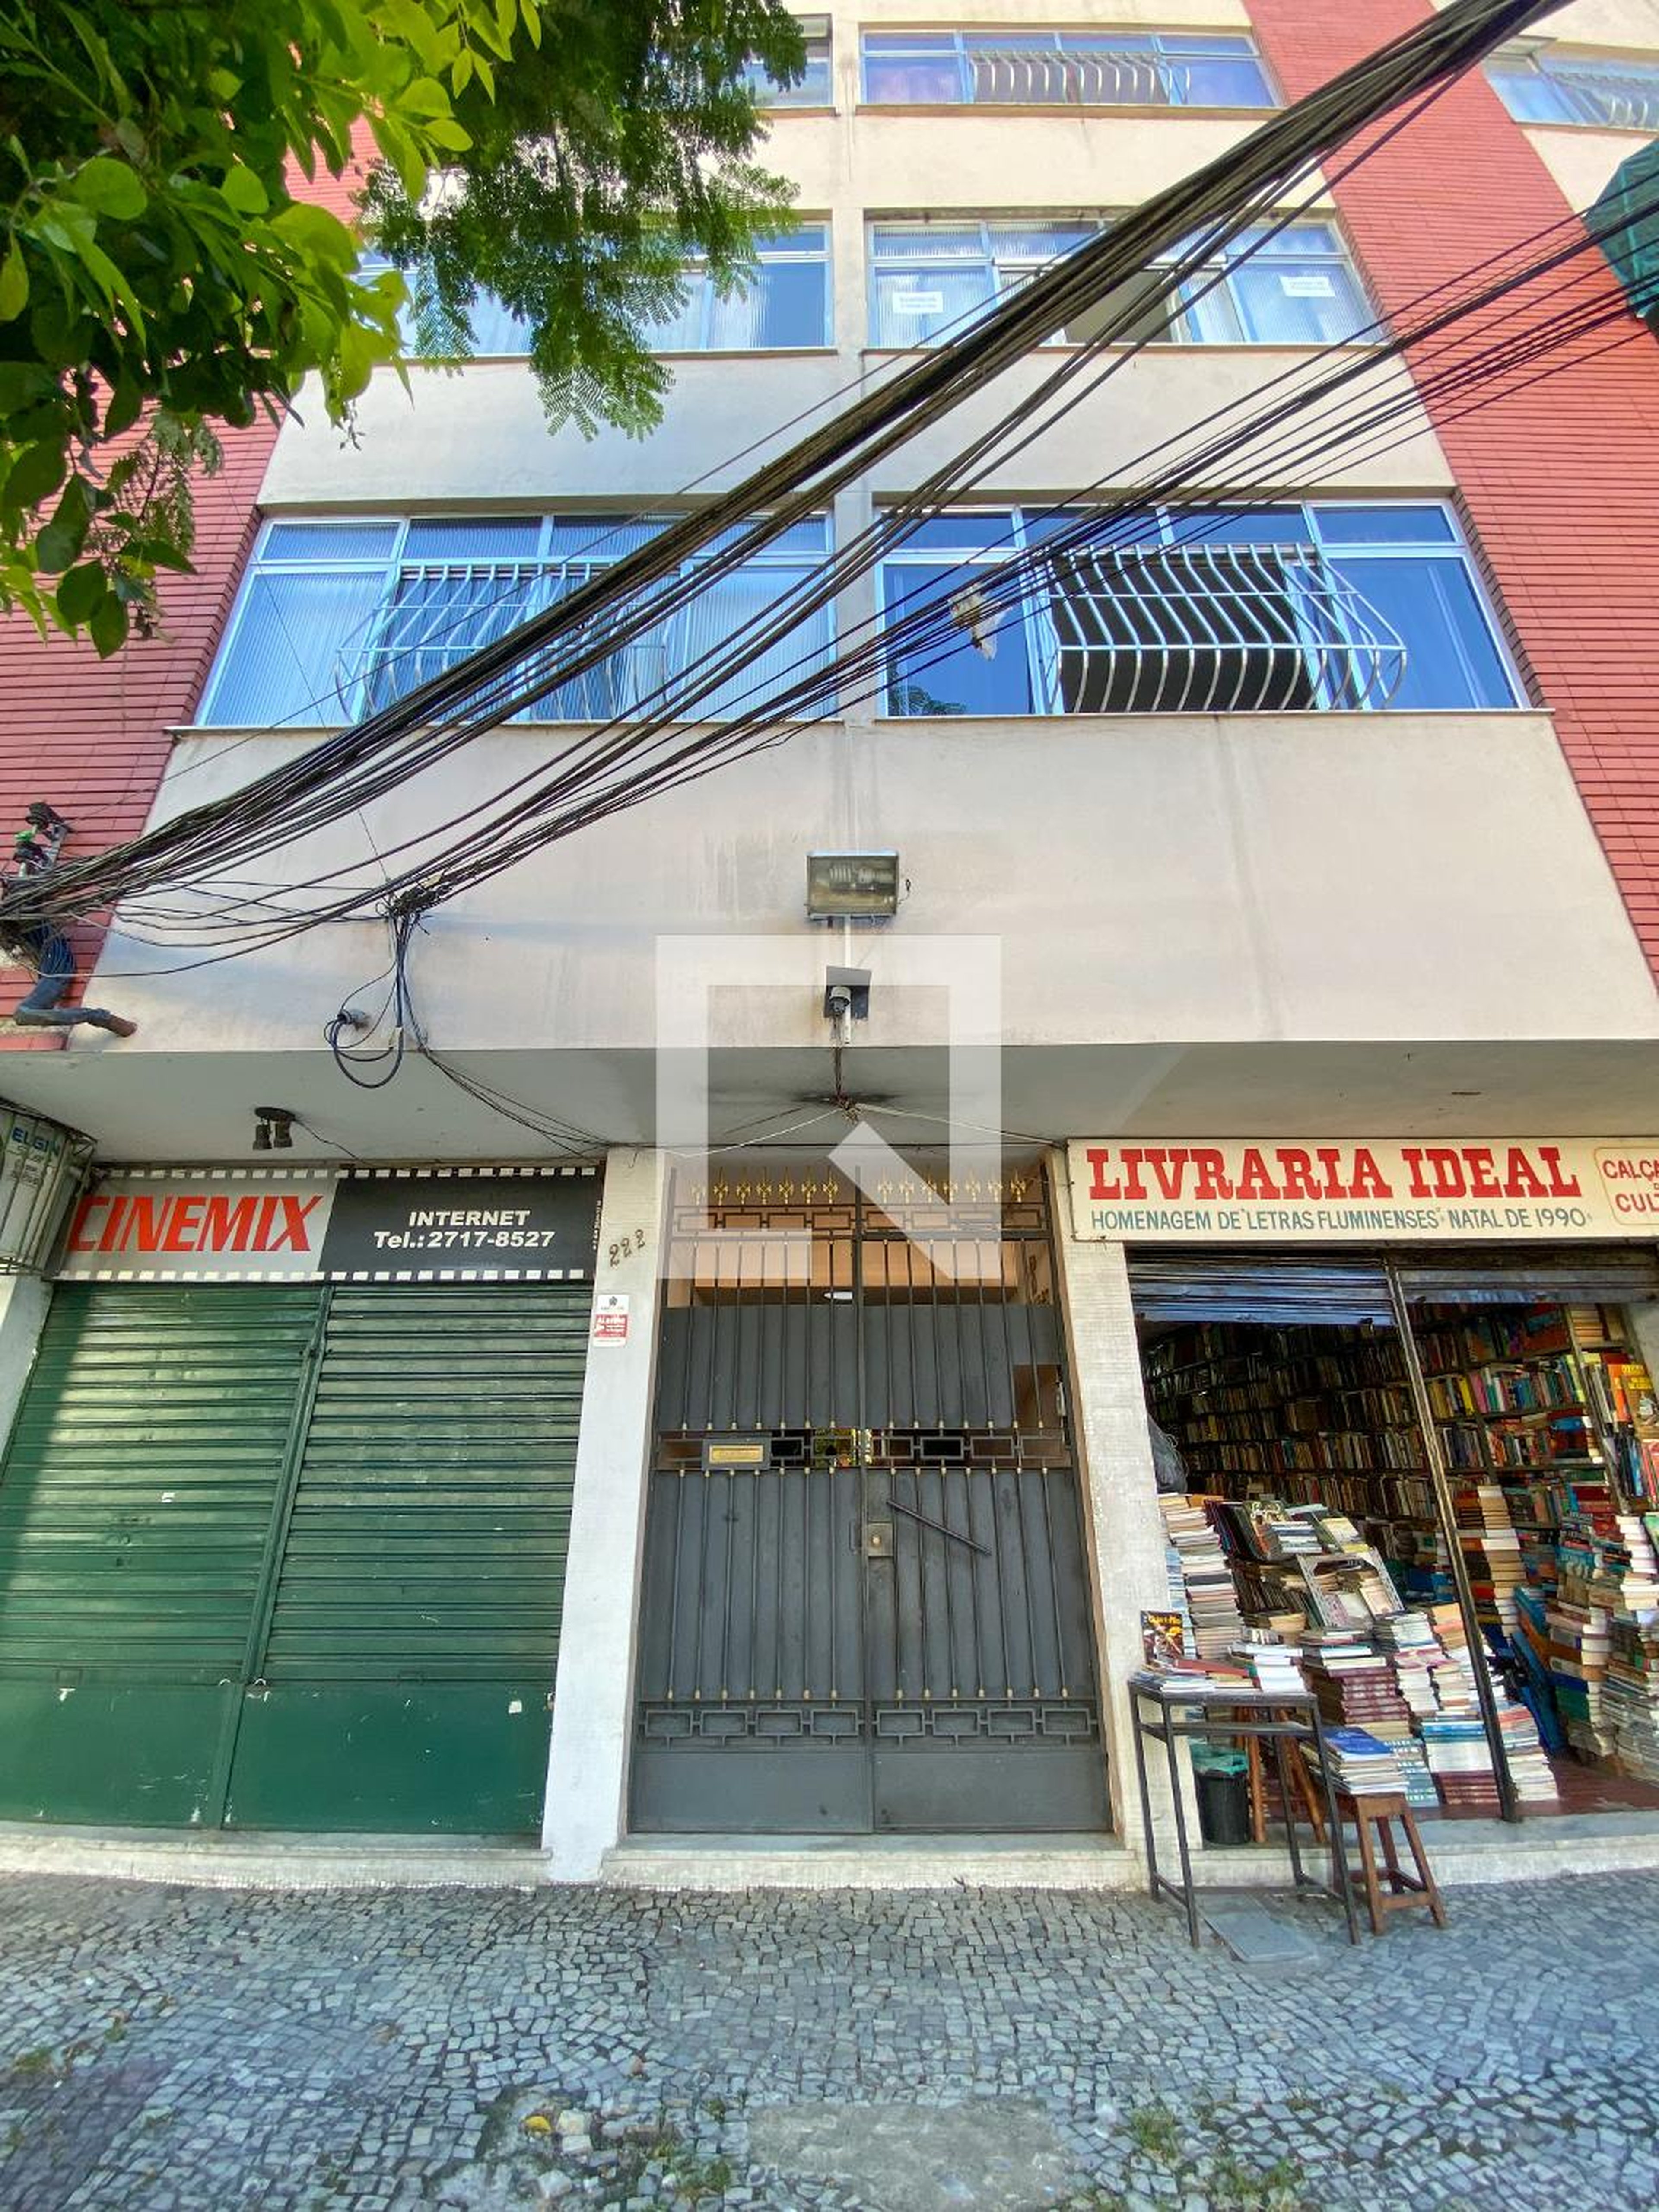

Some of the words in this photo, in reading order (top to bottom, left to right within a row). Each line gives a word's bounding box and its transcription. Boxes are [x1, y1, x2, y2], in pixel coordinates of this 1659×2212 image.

[1087, 1148, 1394, 1200] LIVRARIA
[1401, 1147, 1582, 1198] IDEAL
[68, 1195, 324, 1252] CINEMIX
[408, 1210, 531, 1227] INTERNET
[1091, 1209, 1211, 1230] HOMENAGEM
[1217, 1211, 1242, 1229] DE
[1448, 1209, 1504, 1229] NATAL
[1504, 1208, 1532, 1228] DE
[1535, 1207, 1586, 1228] 1990
[427, 1231, 556, 1248] 2717-8527
